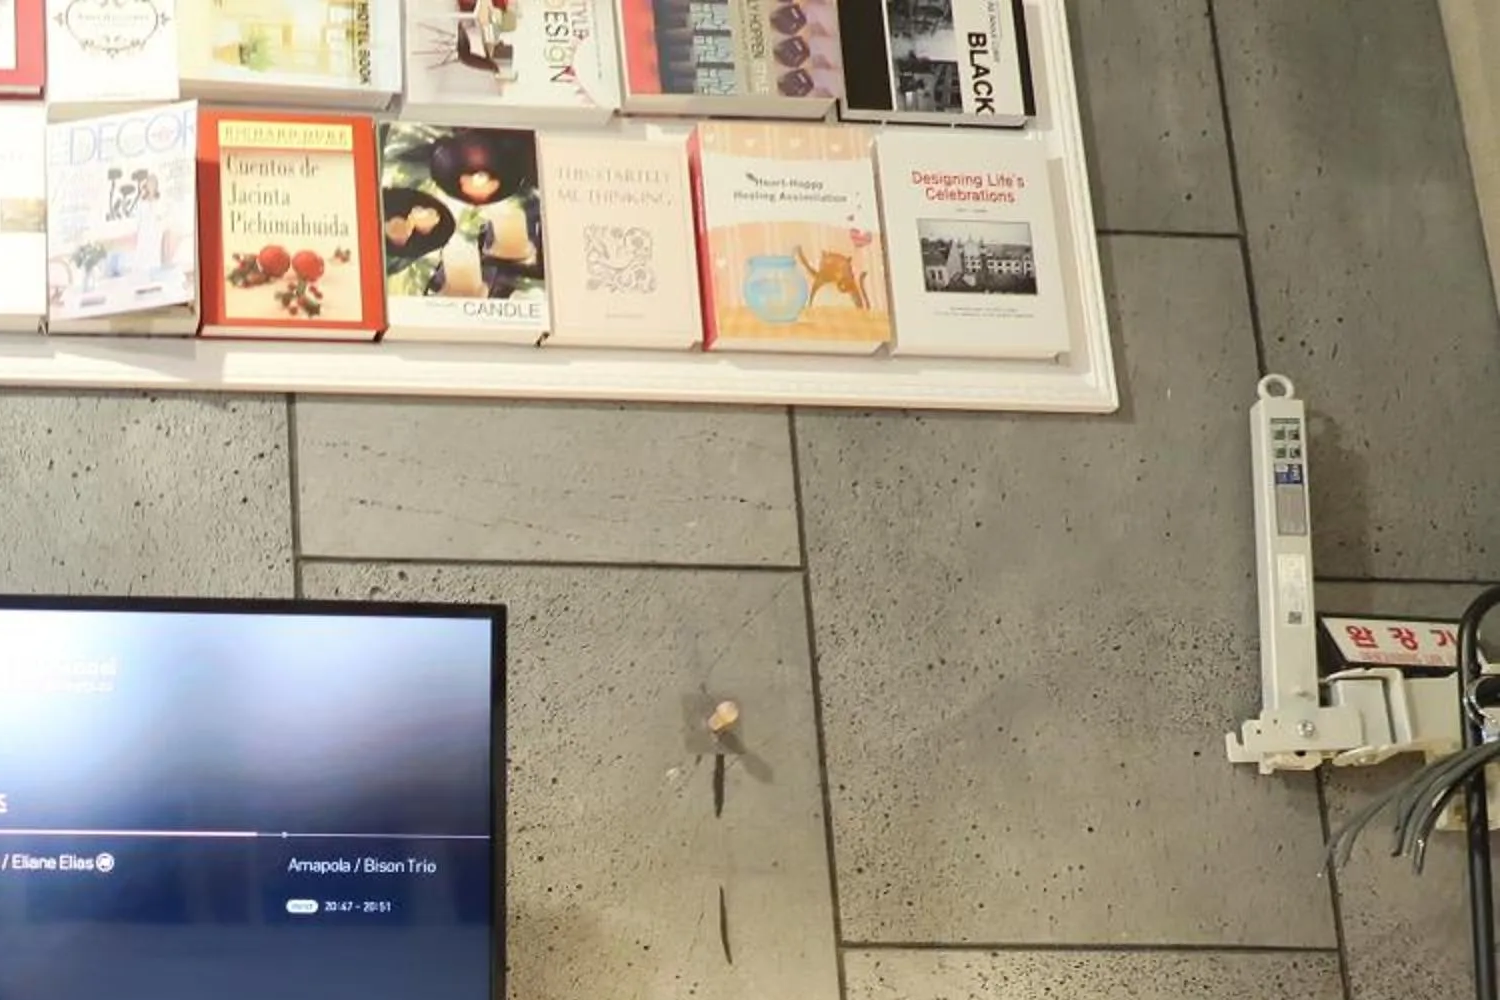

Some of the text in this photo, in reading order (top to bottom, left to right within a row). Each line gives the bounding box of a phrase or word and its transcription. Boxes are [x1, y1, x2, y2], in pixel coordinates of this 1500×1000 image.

[967, 31, 995, 116] BLACK
[225, 153, 320, 177] Cuentos de
[911, 171, 1026, 188] Designing Life's
[227, 181, 291, 207] Jacinta
[924, 187, 1016, 203] Celebrations
[462, 301, 542, 319] CANDLE
[11, 853, 57, 870] Eliane
[59, 855, 95, 871] Elias
[287, 857, 352, 875] Amapola
[363, 857, 405, 873] Bison
[407, 858, 438, 874] Trio
[324, 901, 353, 912] 20:47
